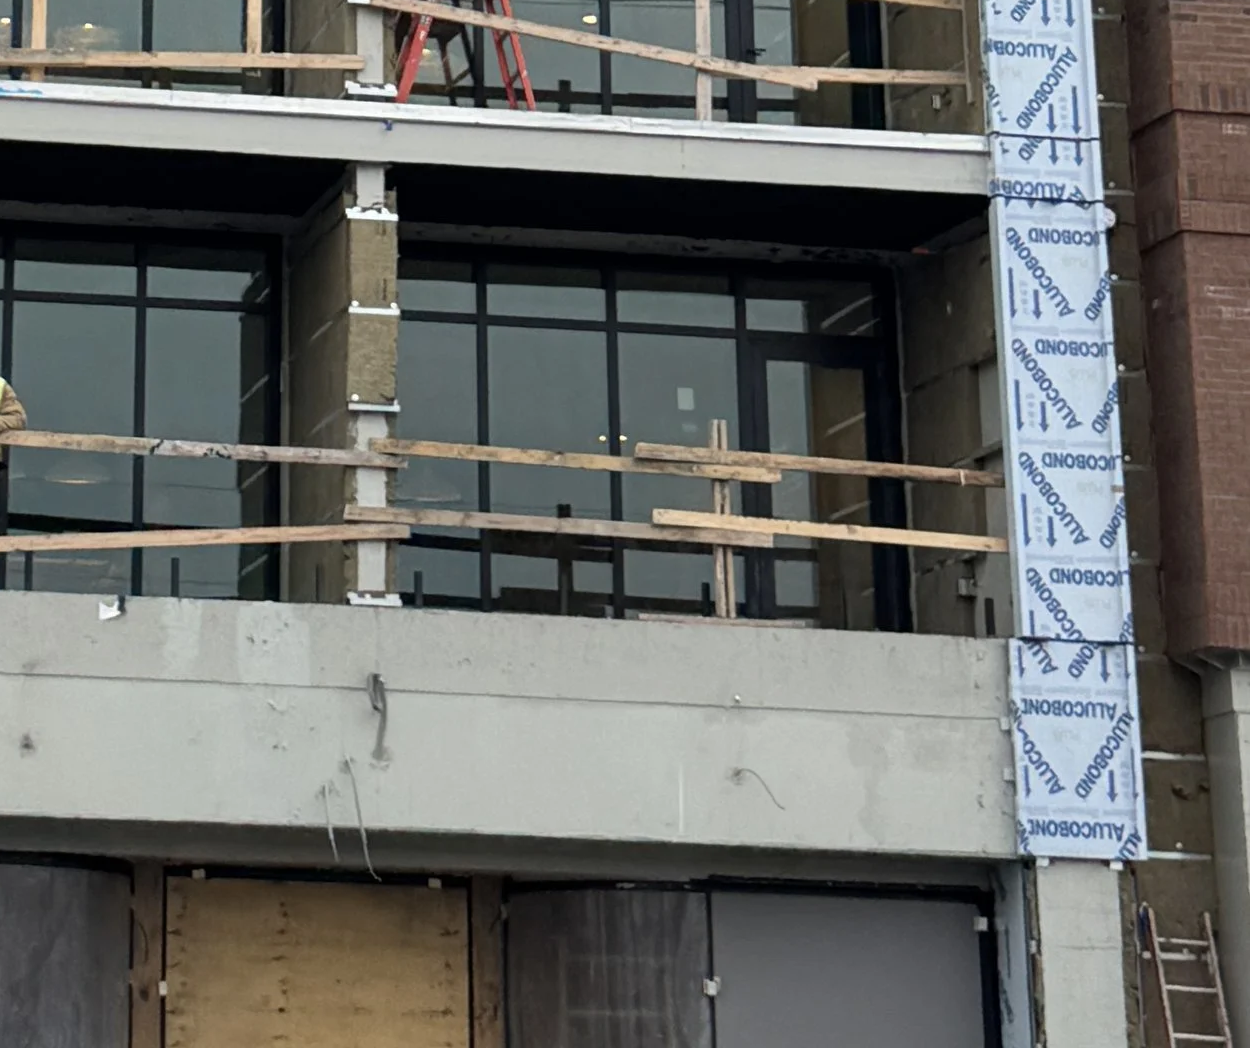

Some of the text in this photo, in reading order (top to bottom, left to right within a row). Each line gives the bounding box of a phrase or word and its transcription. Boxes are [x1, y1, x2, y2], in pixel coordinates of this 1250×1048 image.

[1015, 46, 1079, 131] ALUCOBOND
[1005, 226, 1076, 319] ALUCOBOND
[1011, 338, 1084, 431] ALUCOBOND
[1018, 451, 1091, 546] ALUCOBOND
[1075, 709, 1135, 800] ALUCOBOND
